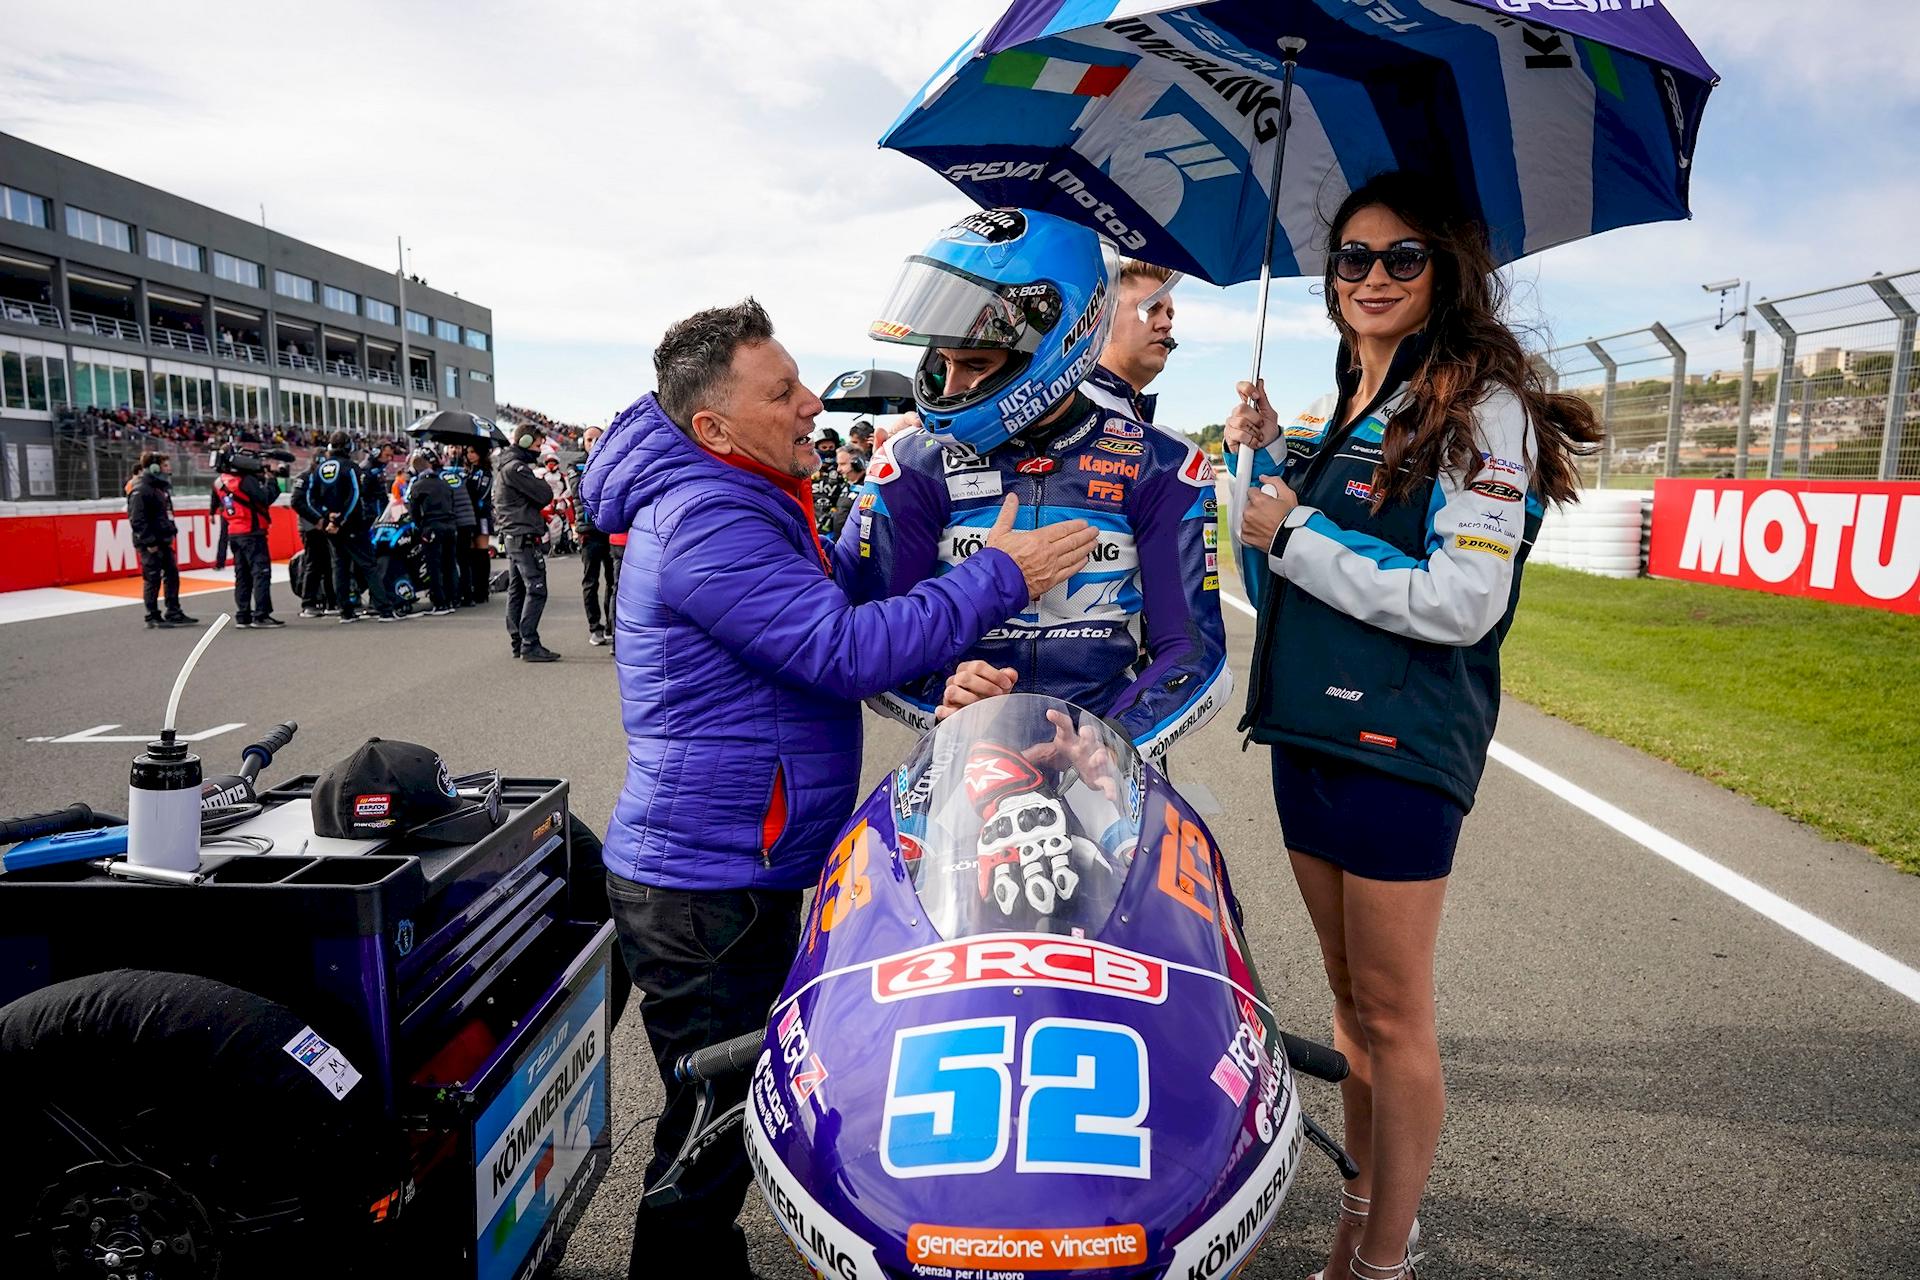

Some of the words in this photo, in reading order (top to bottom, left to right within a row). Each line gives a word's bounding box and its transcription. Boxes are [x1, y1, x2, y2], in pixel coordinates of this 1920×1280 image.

[1007, 283, 1048, 298] X-803
[998, 379, 1033, 419] JUST
[1003, 398, 1046, 435] BEER
[1042, 347, 1092, 407] LOVERS
[1053, 413, 1098, 451] alpinestars
[1078, 454, 1140, 480] Kapriol
[1483, 522, 1503, 533] DELLA
[1678, 488, 1920, 600] MOTU
[1468, 539, 1510, 556] DUNLOP
[1147, 694, 1214, 759] KÖMMERLING
[966, 941, 1152, 992] RCB
[335, 1082, 344, 1093] 4
[762, 1062, 794, 1134] HOLIDAY
[879, 1015, 1152, 1180] 52
[490, 1029, 596, 1201] KÖMMERLING
[915, 1233, 1044, 1259] generazione
[1049, 1232, 1137, 1258] vincente
[911, 1262, 953, 1279] Agenzia
[955, 1268, 975, 1280] per
[986, 1270, 1025, 1280] Lavoro
